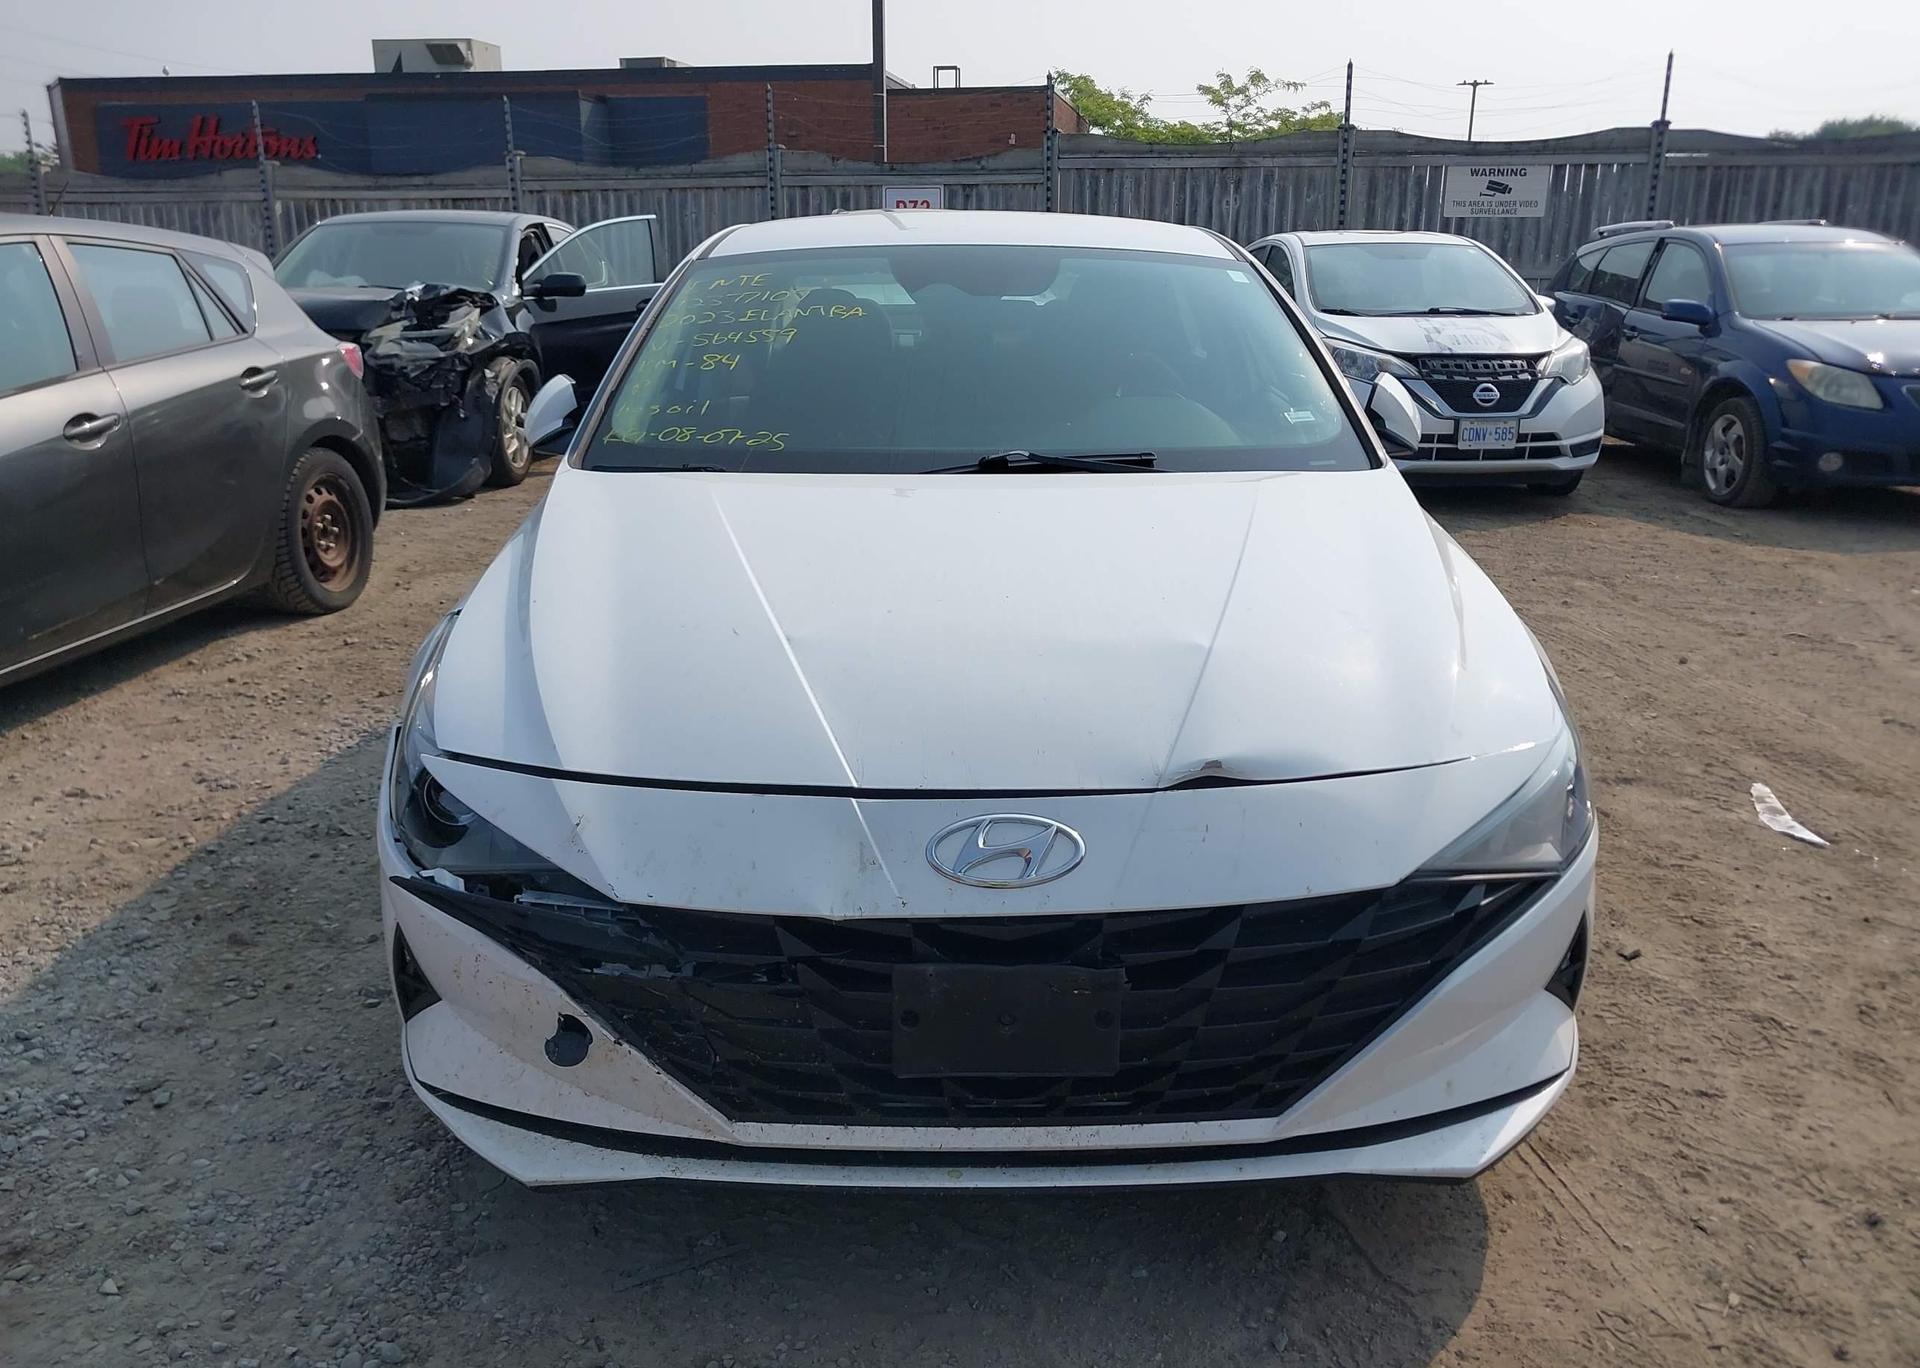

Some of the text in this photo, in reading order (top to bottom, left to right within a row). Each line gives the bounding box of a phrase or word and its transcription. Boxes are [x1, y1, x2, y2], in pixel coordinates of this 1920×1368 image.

[121, 113, 319, 162] Tim Hortons
[1470, 167, 1528, 178] WARNING
[1452, 200, 1539, 208] THIS AREA IS UNDER VIDEO
[1461, 426, 1514, 442] CDNV 585
